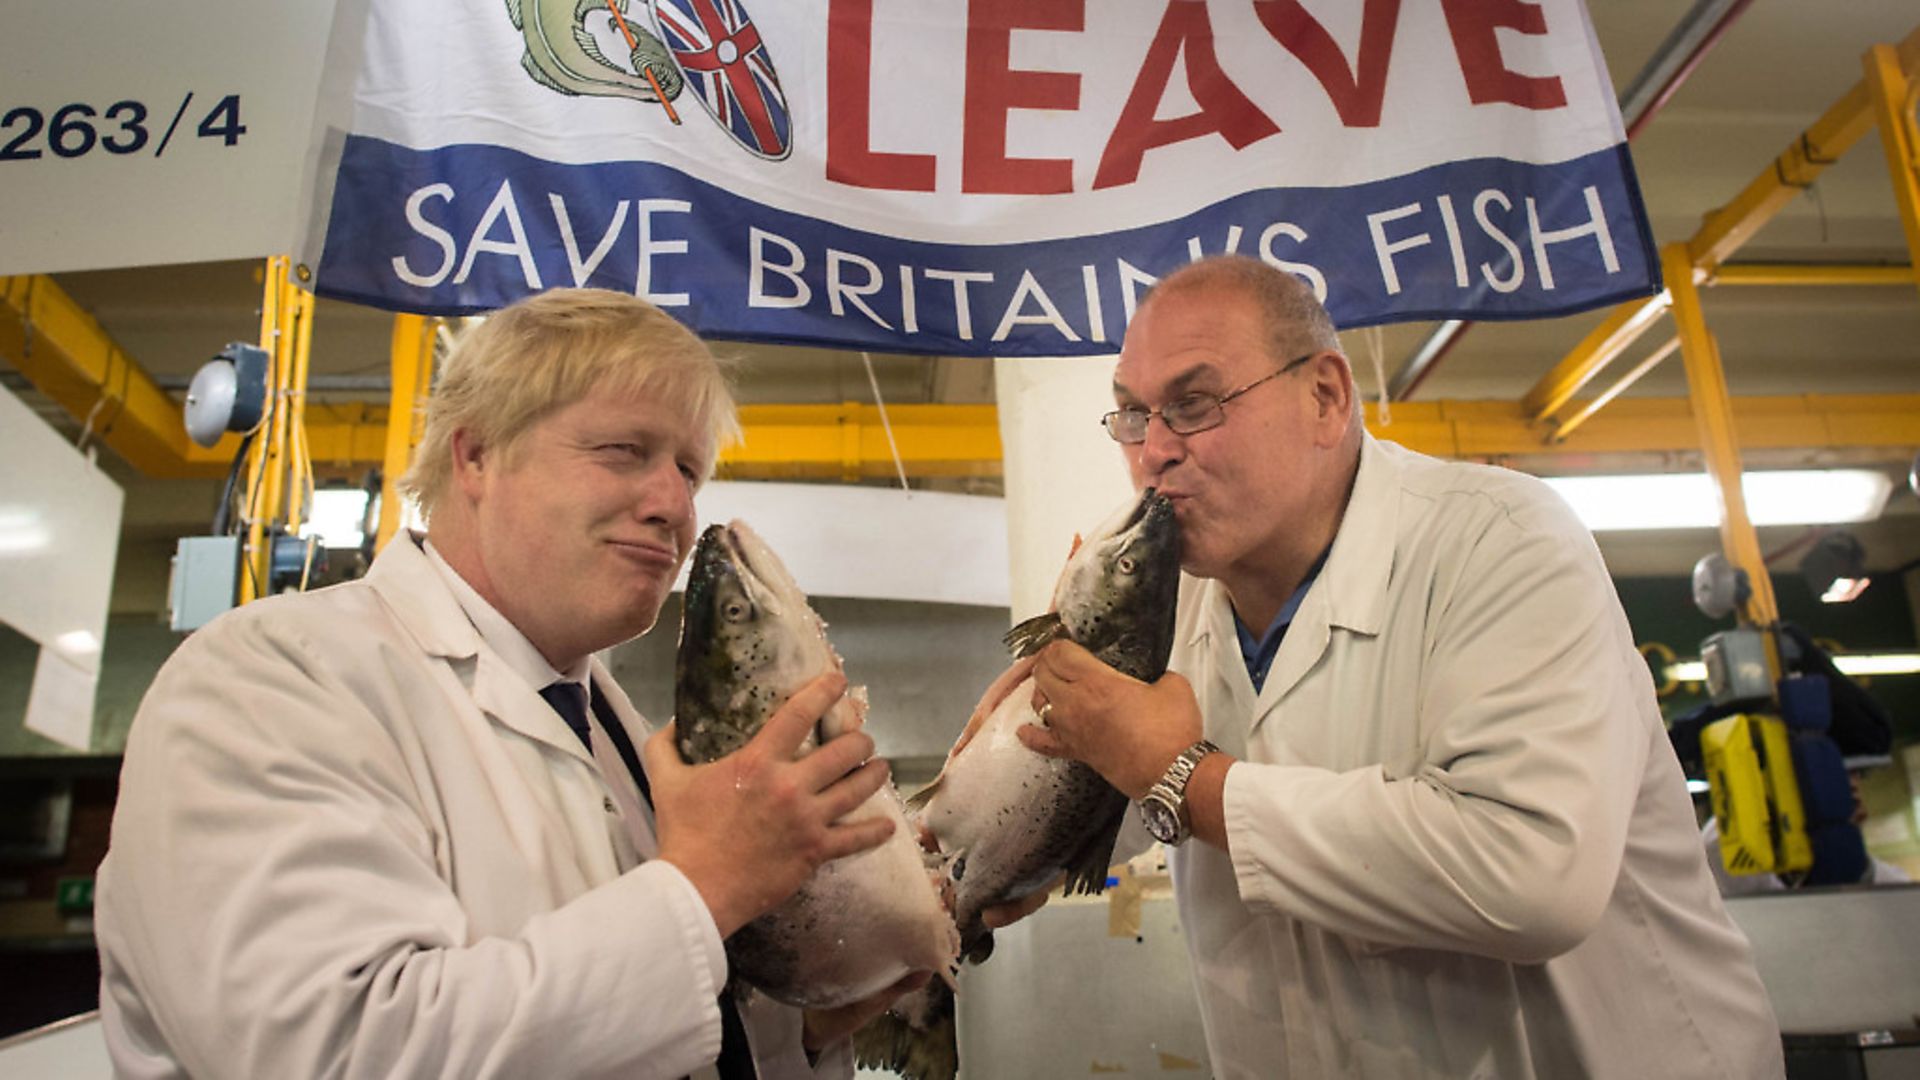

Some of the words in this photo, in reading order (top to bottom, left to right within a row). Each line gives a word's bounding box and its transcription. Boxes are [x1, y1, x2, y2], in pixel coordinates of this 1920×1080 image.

[0, 91, 247, 161] 263/4
[826, 0, 1568, 195] LEAVE
[391, 178, 692, 306] SAVE
[1366, 185, 1621, 295] FISH
